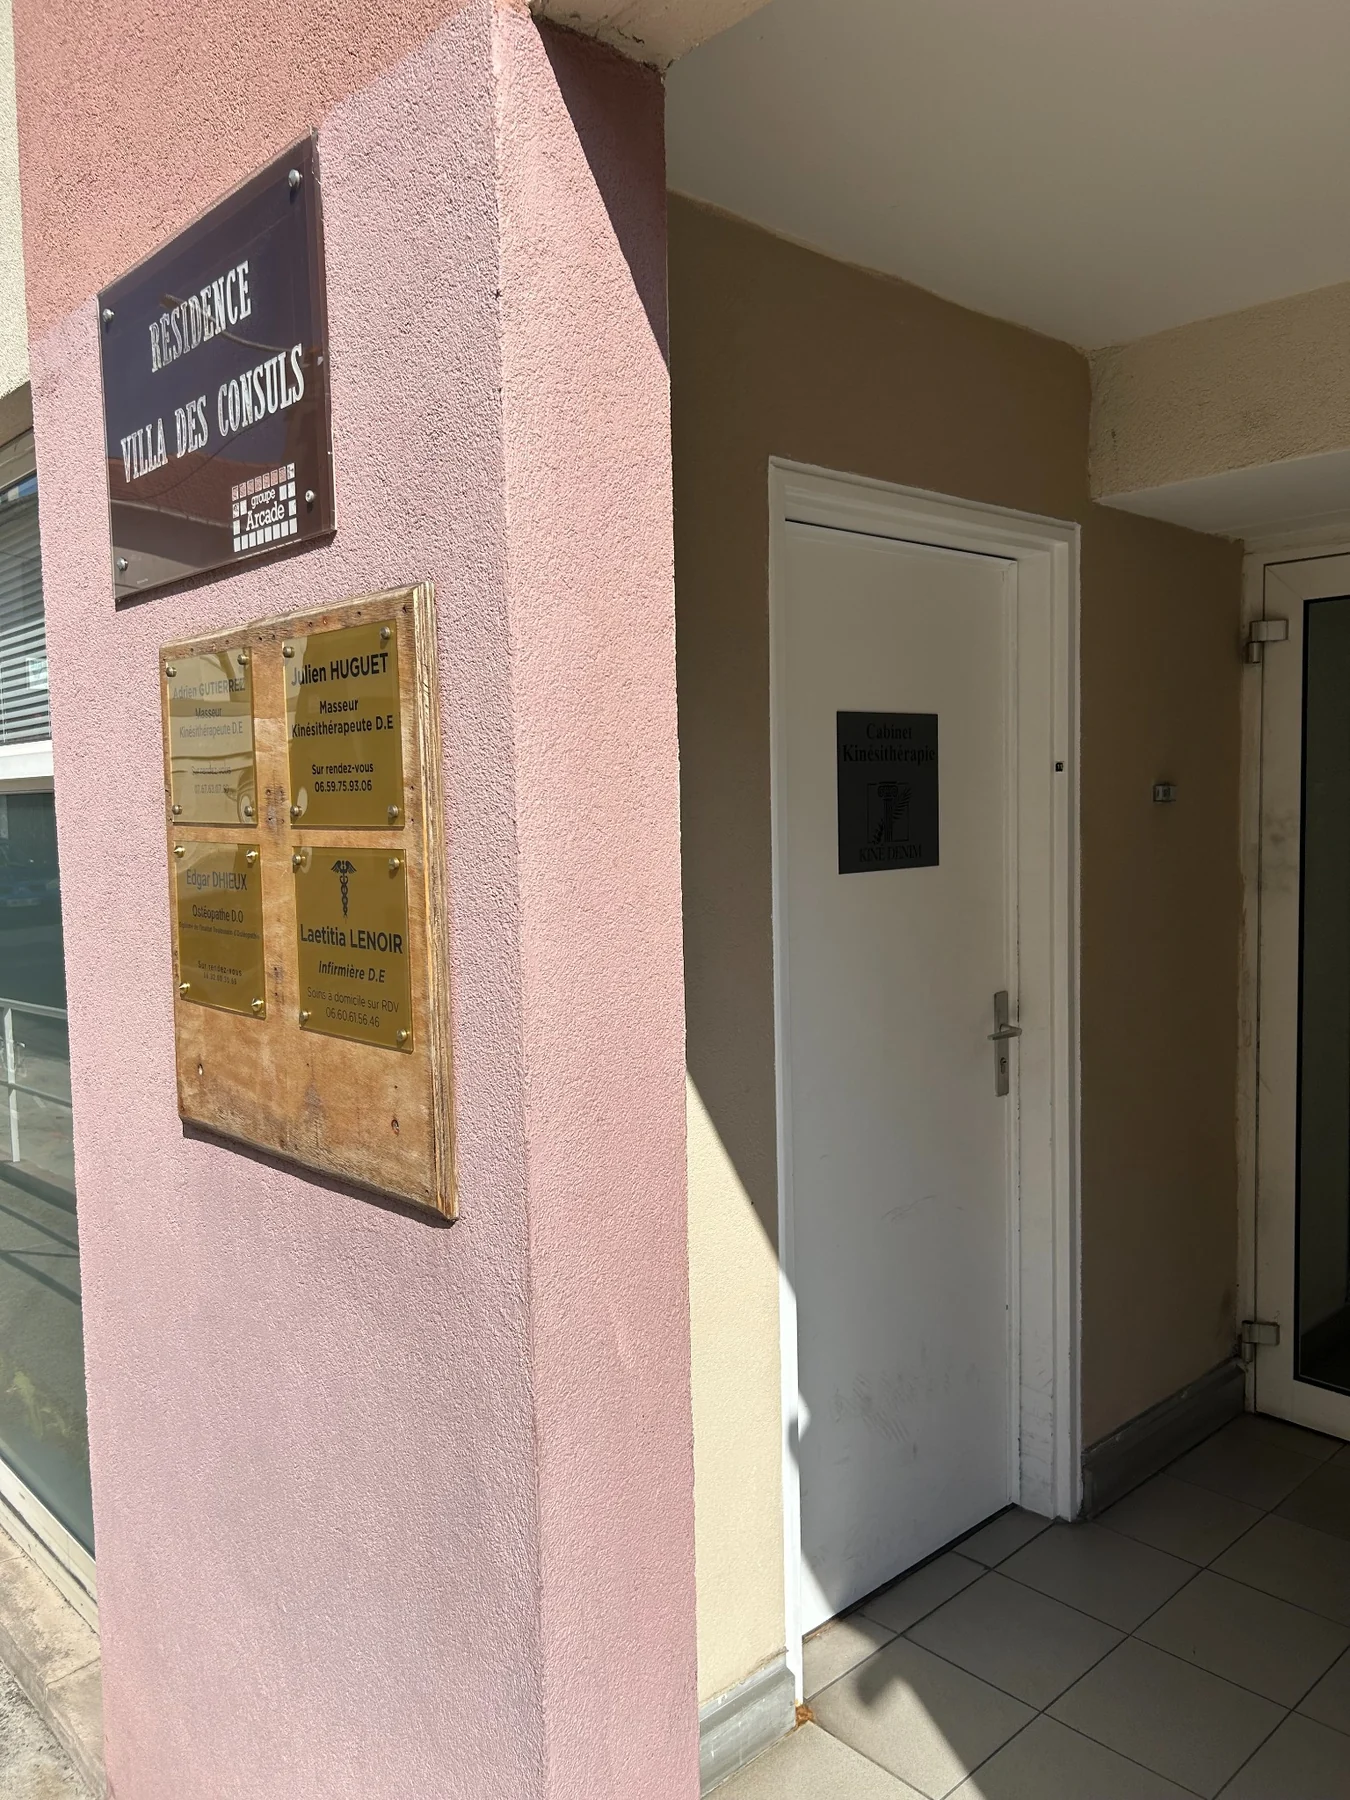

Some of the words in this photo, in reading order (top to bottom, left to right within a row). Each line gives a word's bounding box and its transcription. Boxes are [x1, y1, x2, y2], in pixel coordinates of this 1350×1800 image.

[120, 418, 169, 483] VILLA
[174, 394, 209, 459] DES
[217, 343, 305, 437] CONSULS
[250, 488, 276, 509] groupe
[245, 501, 285, 531] Arcade
[291, 664, 327, 687] Julien
[330, 652, 389, 681] HUGUET
[319, 699, 359, 714] Masseur
[291, 717, 373, 738] Kinésithérapeute
[375, 715, 394, 731] D.E
[865, 722, 913, 740] Cabinet
[311, 764, 324, 775] Sur
[325, 762, 374, 774] rendez-vous
[314, 779, 373, 793] 06.59.75.93.06
[186, 868, 210, 890] Edgar
[212, 871, 248, 891] DHIEUX
[192, 904, 230, 922] Ostéopathe
[300, 924, 347, 947] Laetitia
[350, 929, 403, 954] LENOIR
[318, 960, 365, 980] Infirmière
[368, 968, 386, 983] D.E
[307, 986, 326, 1000] Soins
[334, 991, 366, 1008] domicile
[367, 999, 380, 1010] sur
[381, 999, 399, 1013] RDV
[325, 1008, 380, 1028] 06.60.61.56.46
